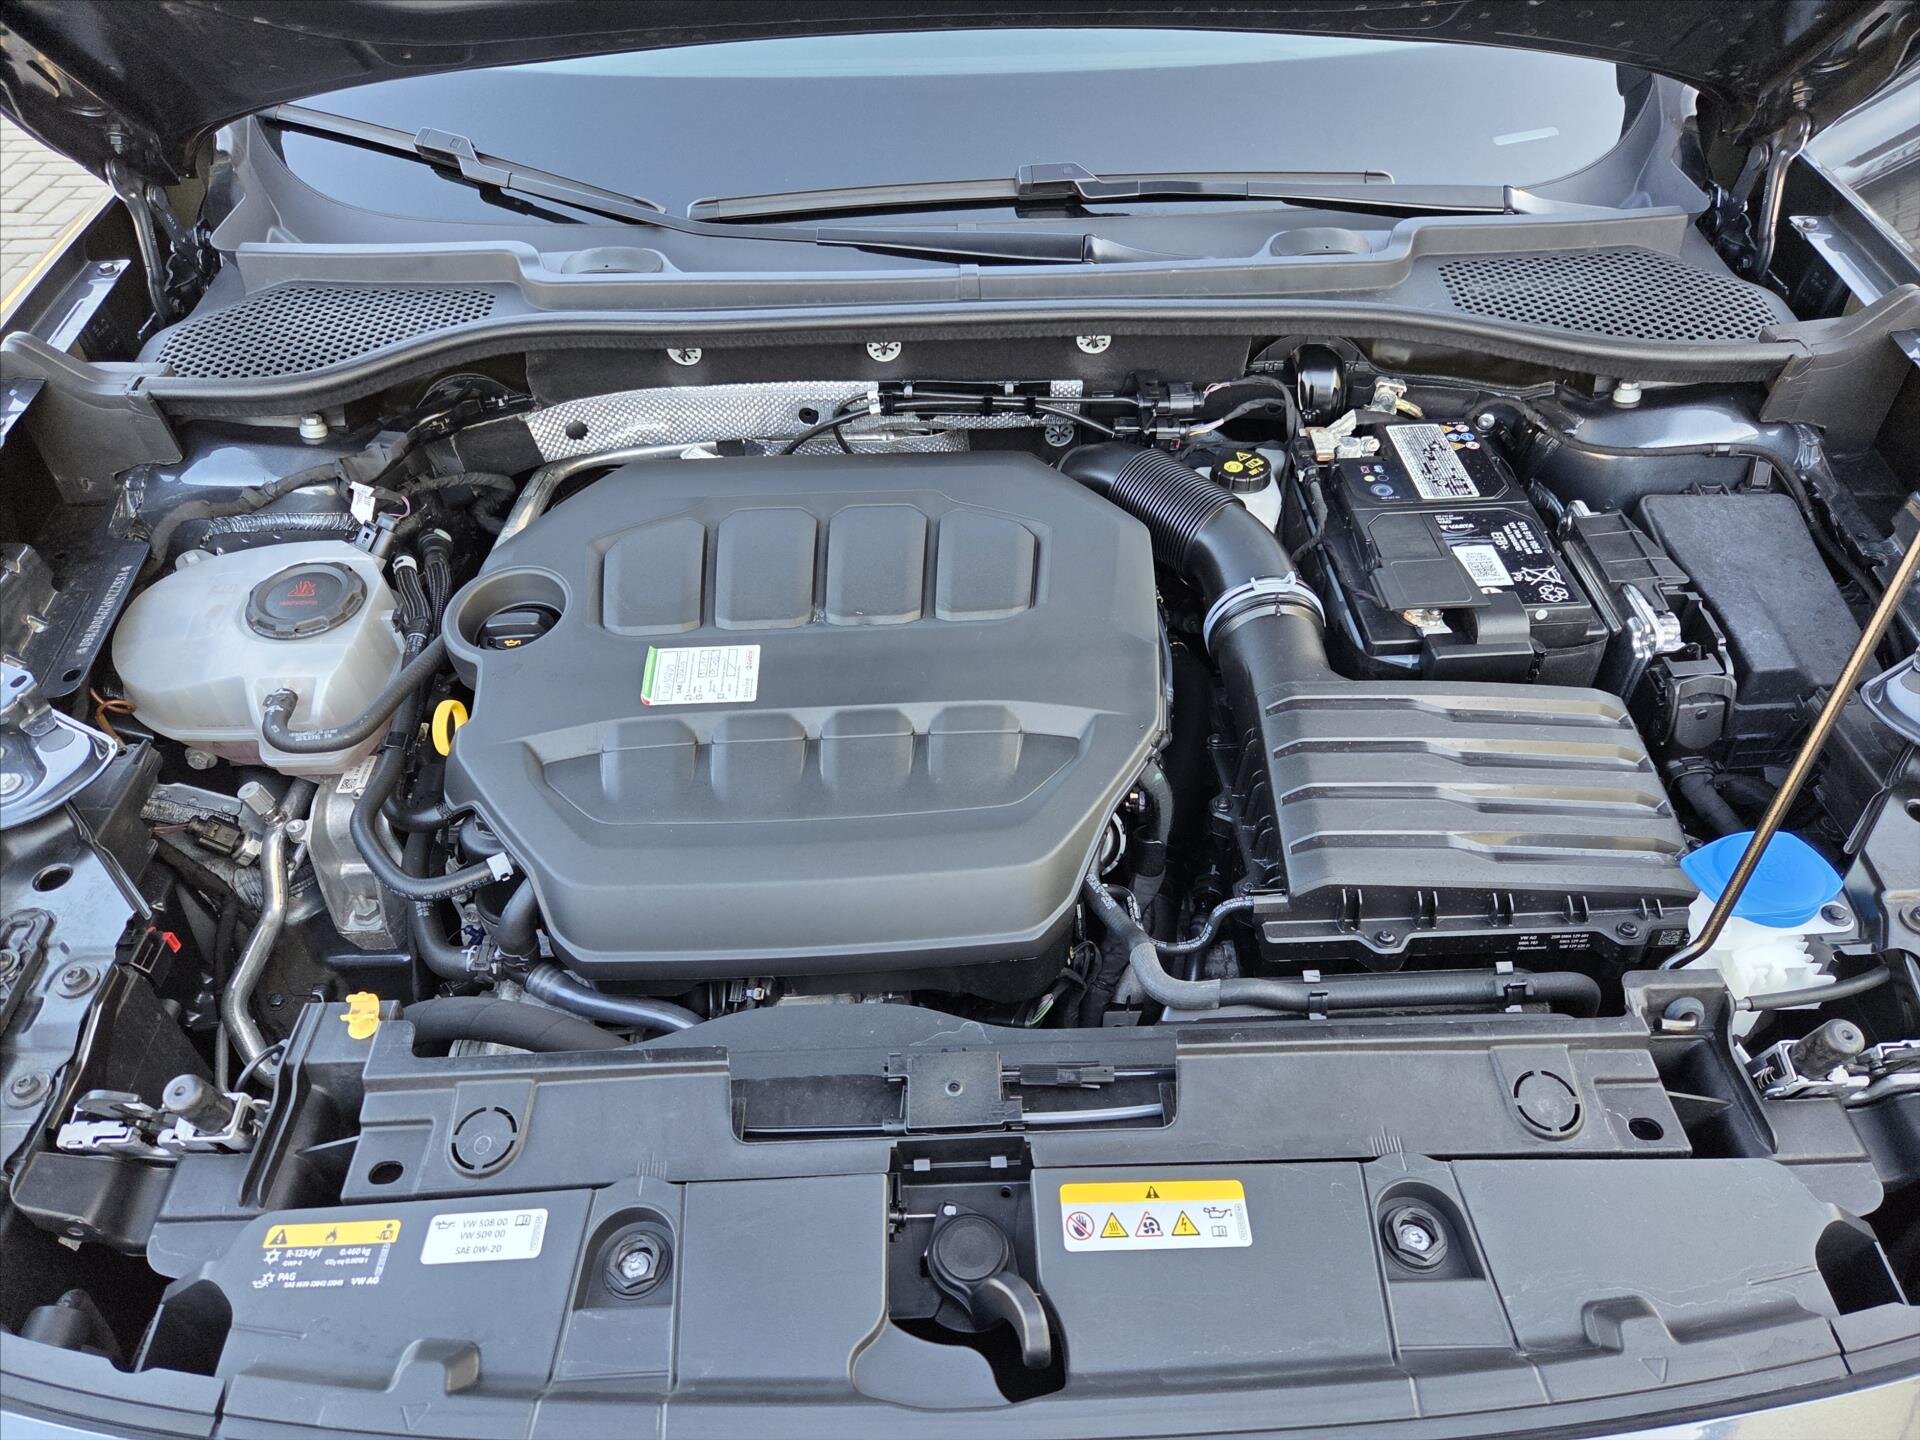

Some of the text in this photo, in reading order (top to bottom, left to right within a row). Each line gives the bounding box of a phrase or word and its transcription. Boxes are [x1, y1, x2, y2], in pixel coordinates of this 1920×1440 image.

[463, 1217, 508, 1228] VW 508 00
[460, 1229, 506, 1240] VW 509 00
[455, 1244, 502, 1255] SAE 0W-20
[277, 1272, 297, 1281] PAG
[351, 1276, 380, 1286] VW AG
